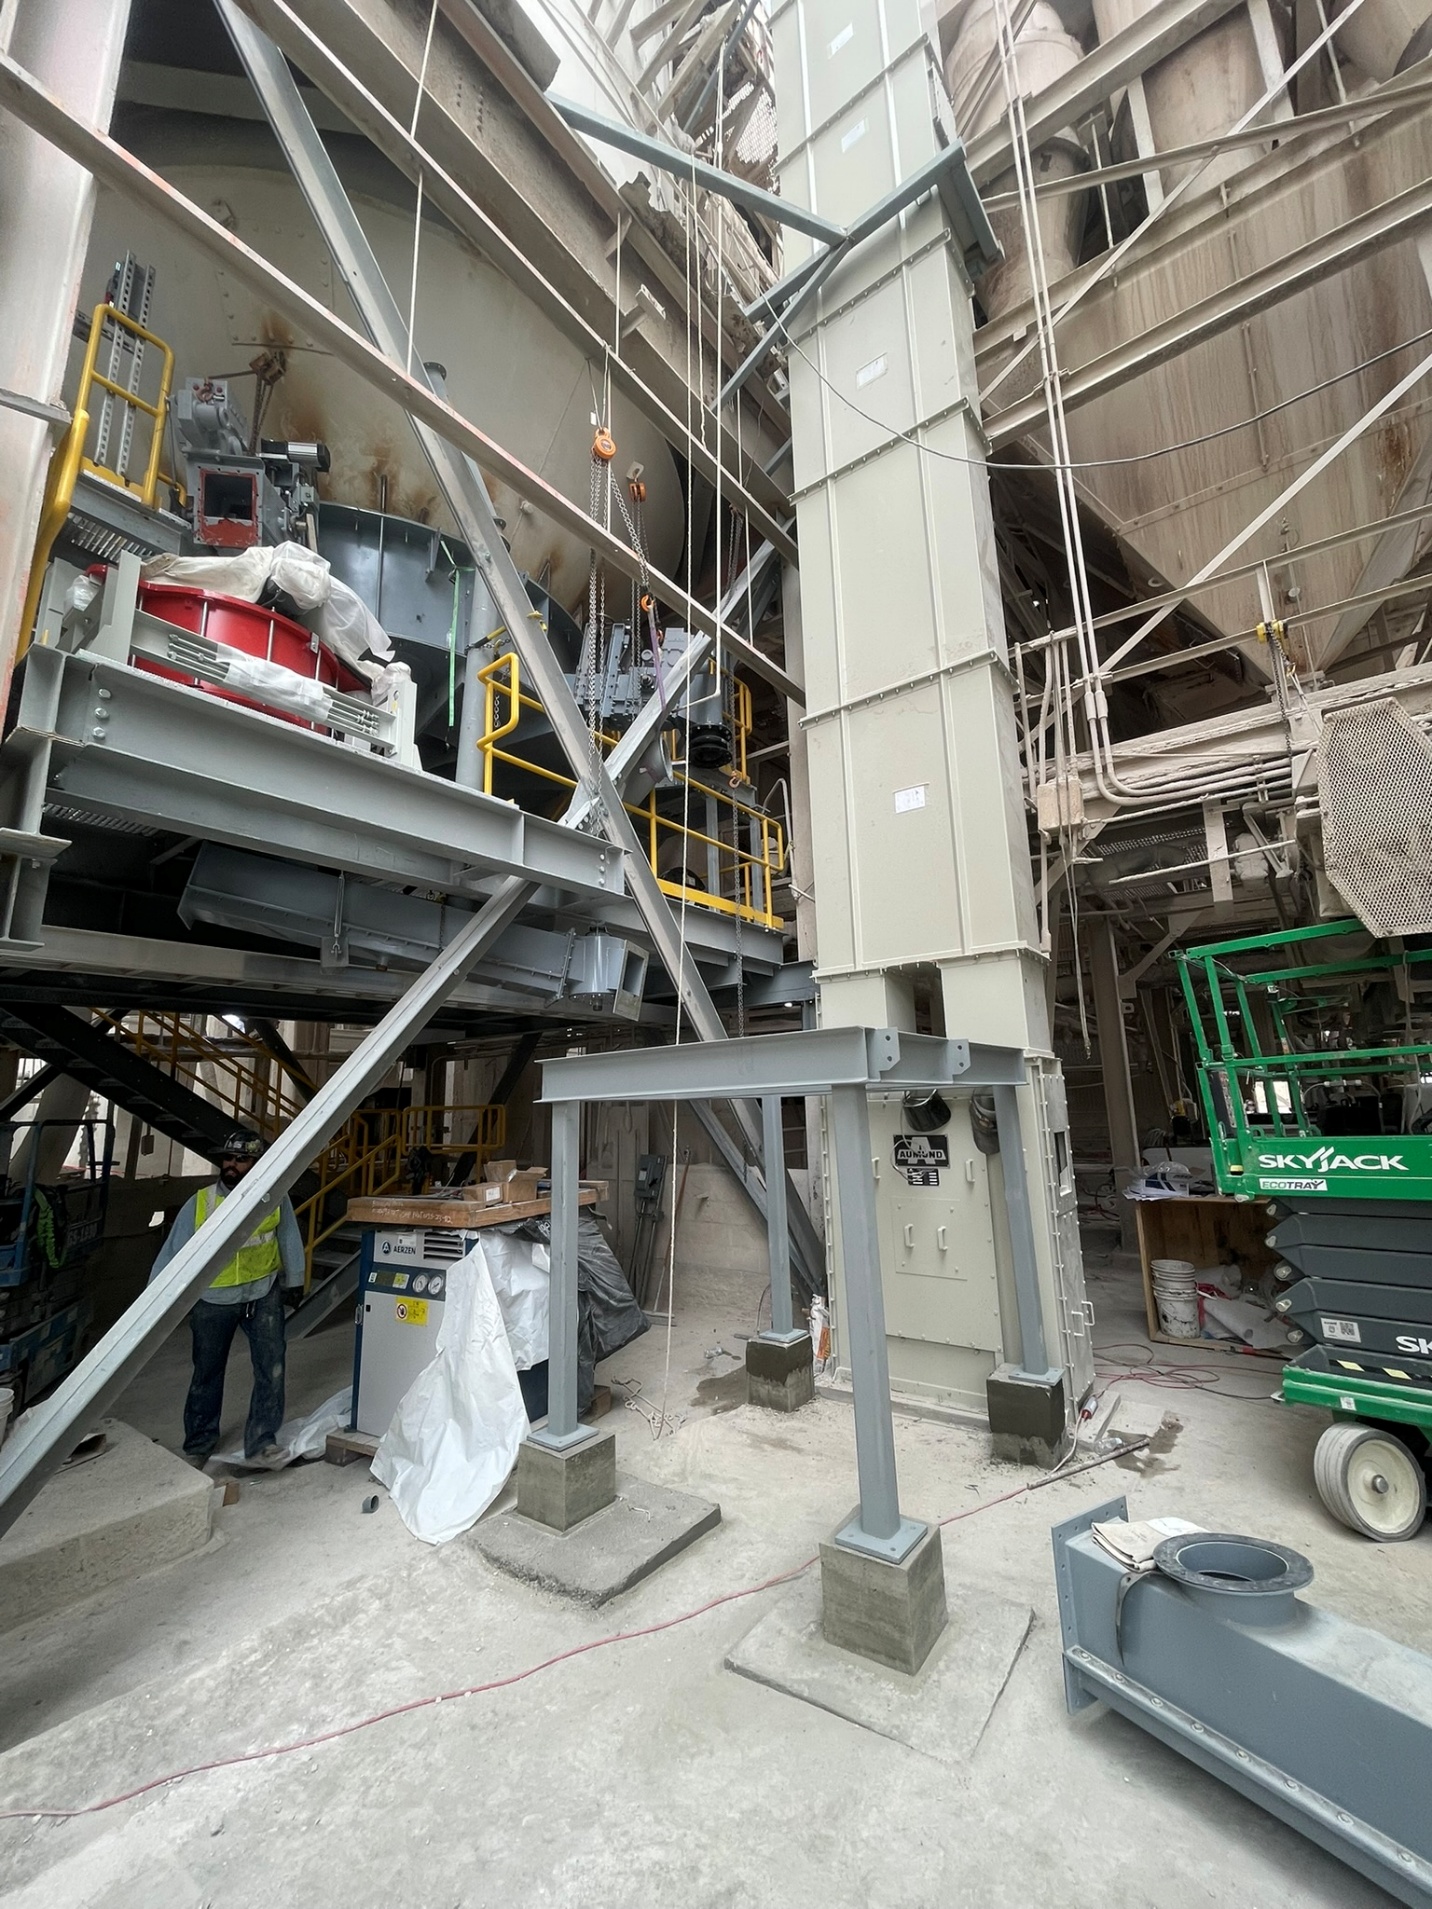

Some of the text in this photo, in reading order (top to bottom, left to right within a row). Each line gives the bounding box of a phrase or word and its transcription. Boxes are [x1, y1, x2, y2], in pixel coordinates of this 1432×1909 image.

[1258, 1146, 1410, 1173] SKYJACK
[1262, 1179, 1324, 1190] ECOTRAY
[393, 1245, 416, 1255] AERZEN
